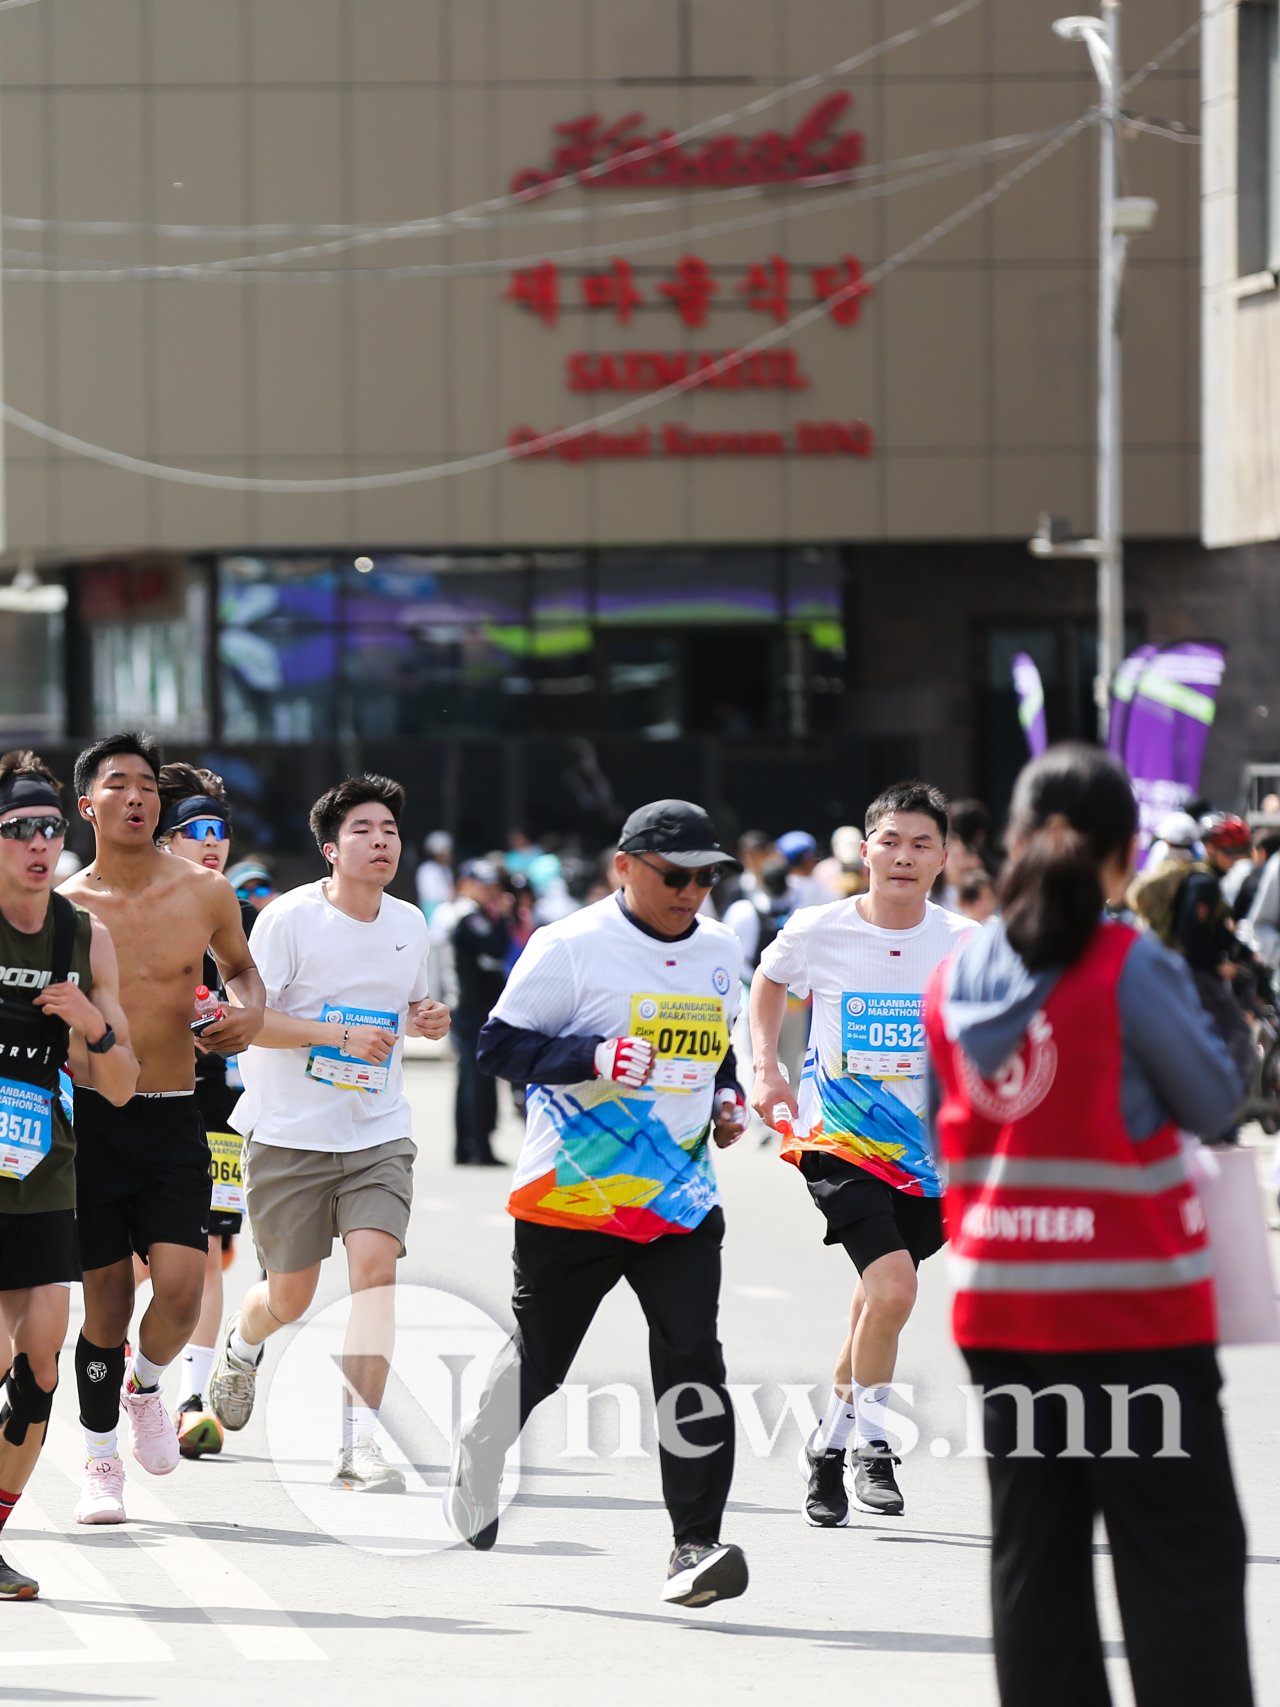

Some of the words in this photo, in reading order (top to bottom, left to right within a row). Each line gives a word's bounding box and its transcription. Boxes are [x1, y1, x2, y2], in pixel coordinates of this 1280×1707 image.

[660, 1001, 716, 1012] ULAANBAATAR
[867, 999, 928, 1008] ULAANBAATA
[660, 1011, 706, 1021] MARATHON
[867, 1008, 920, 1017] MARATHON
[345, 1012, 391, 1026] ULAANBAATAR
[869, 1022, 927, 1048] 0532
[658, 1028, 722, 1056] 07104
[33, 1103, 49, 1115] 2026
[209, 1160, 242, 1182] 064
